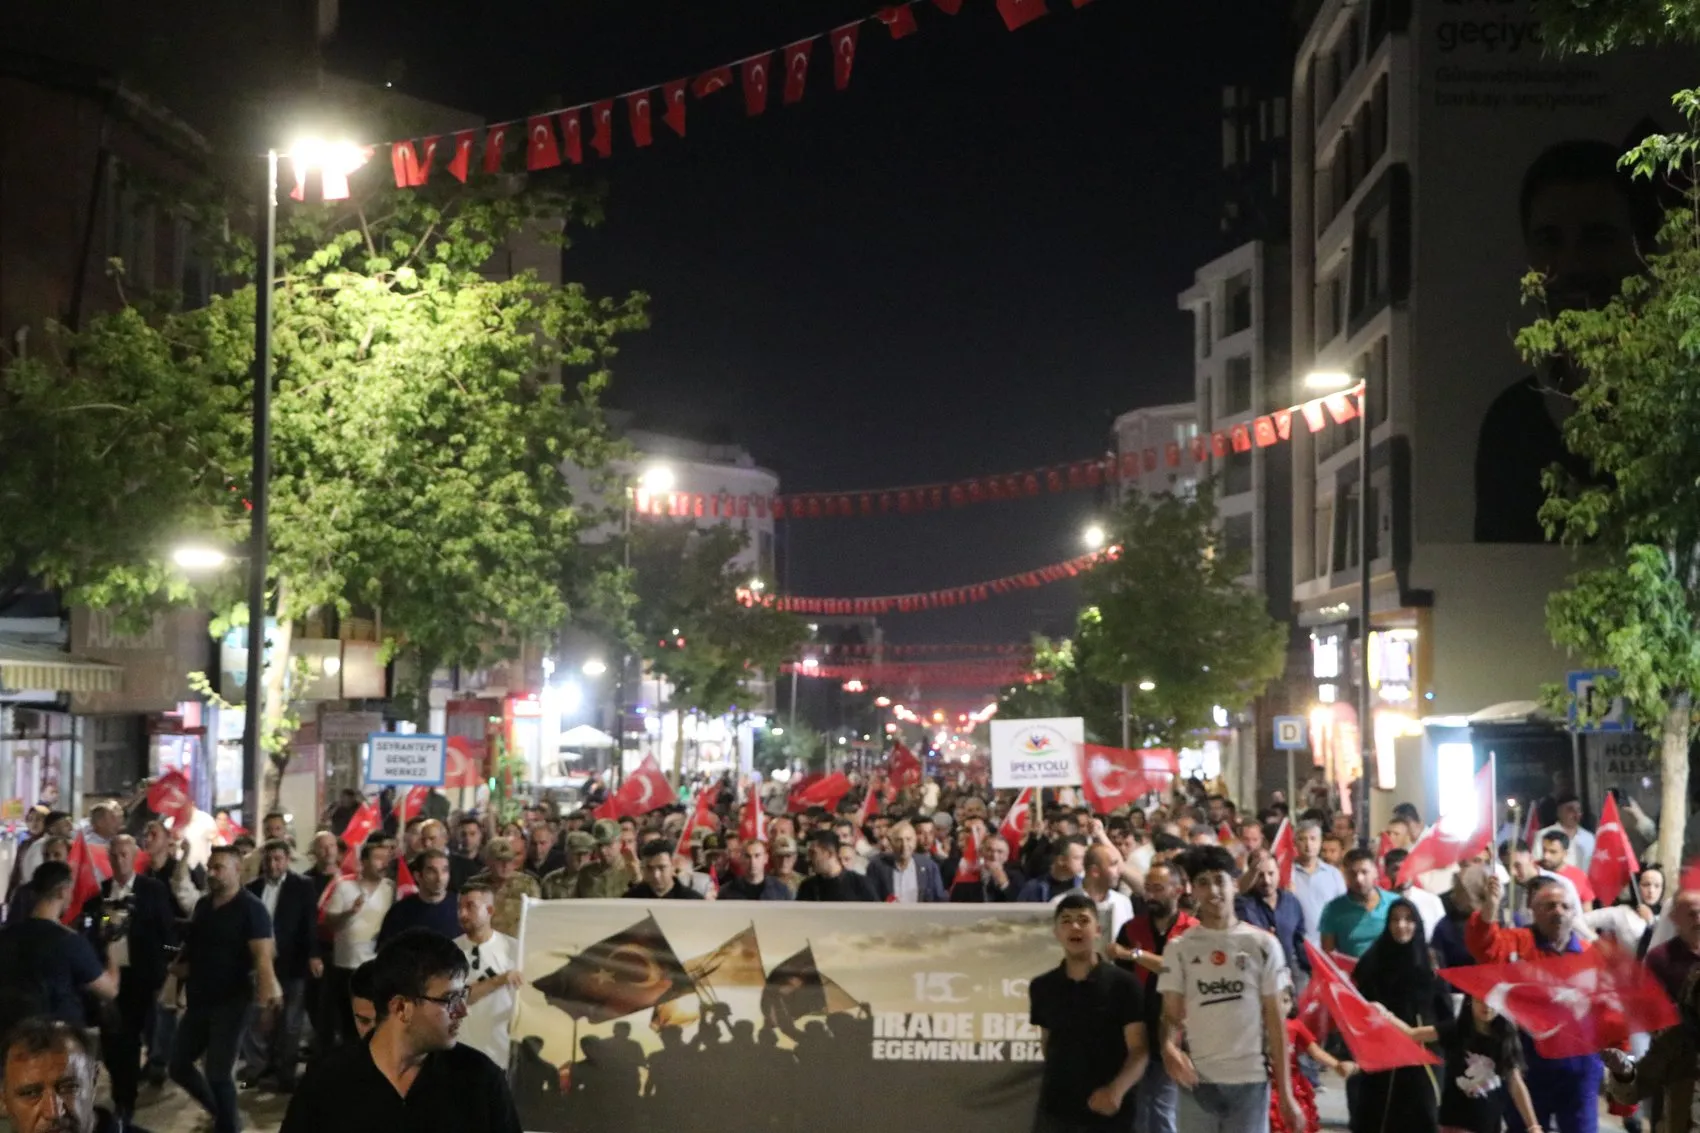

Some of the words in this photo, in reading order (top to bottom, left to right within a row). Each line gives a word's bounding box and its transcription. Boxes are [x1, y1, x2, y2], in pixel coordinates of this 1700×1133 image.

[1283, 724, 1297, 741] D
[376, 742, 438, 752] SEYRANTEPE
[1197, 977, 1243, 995] beko
